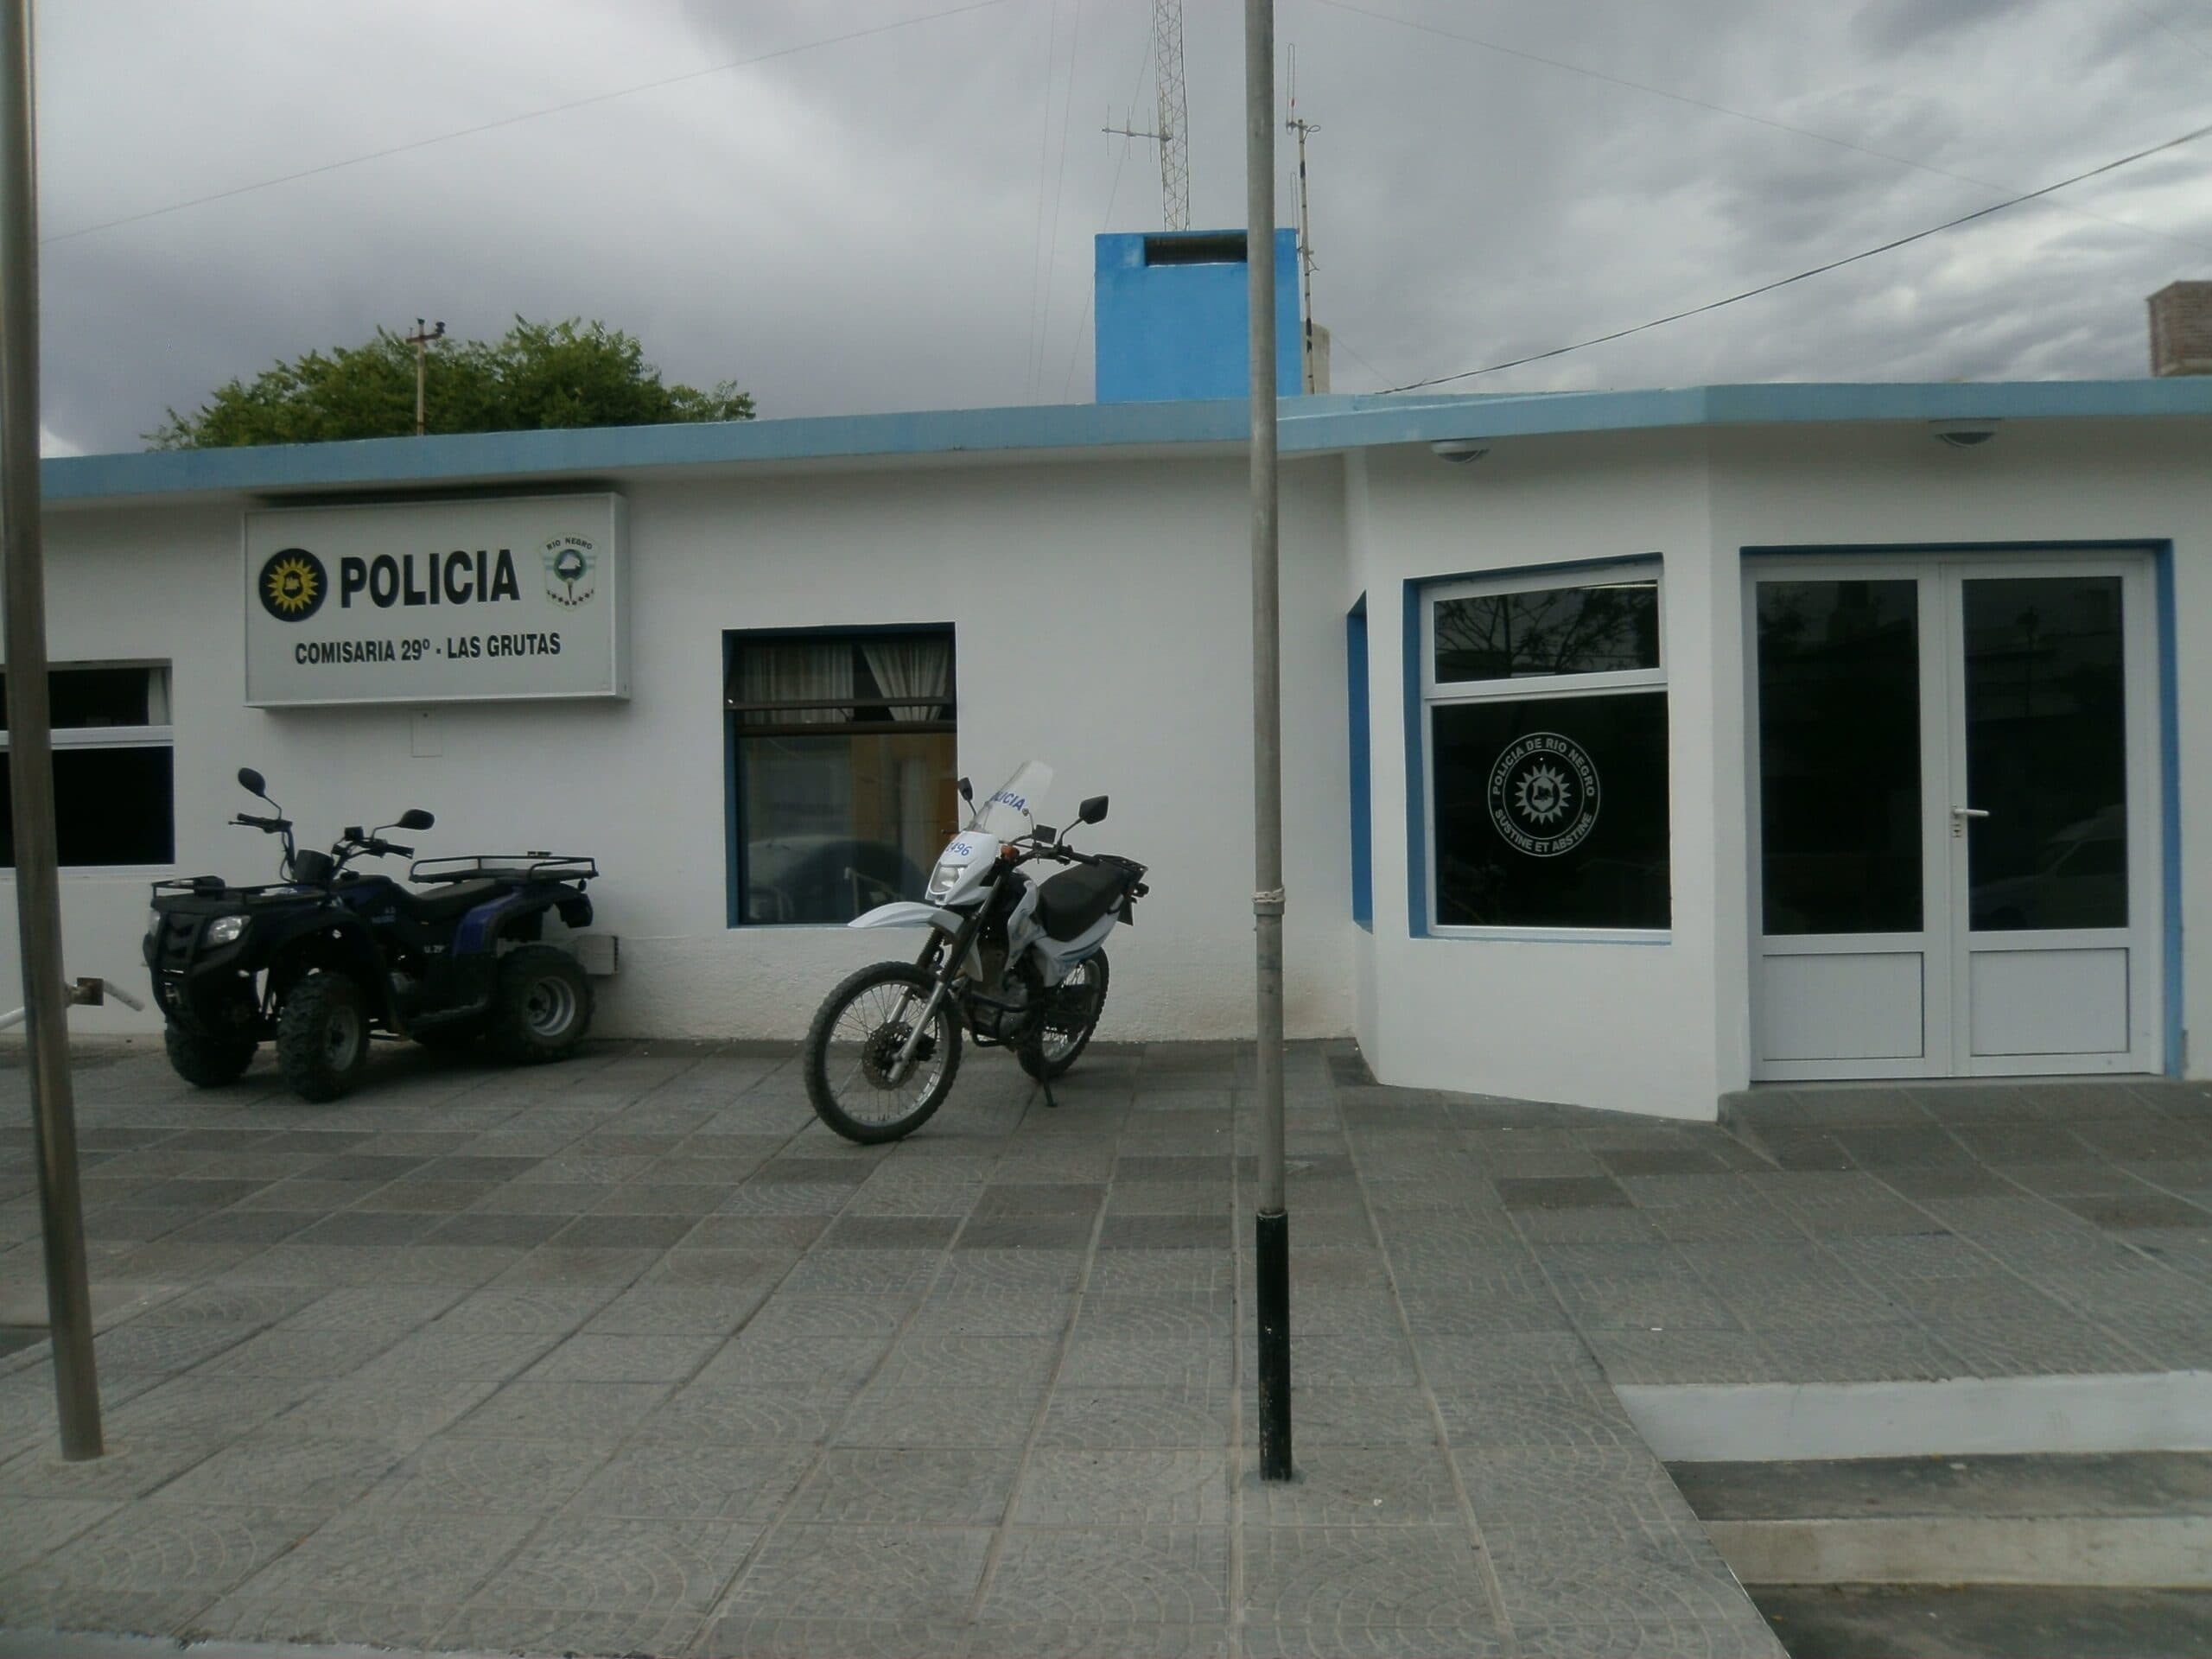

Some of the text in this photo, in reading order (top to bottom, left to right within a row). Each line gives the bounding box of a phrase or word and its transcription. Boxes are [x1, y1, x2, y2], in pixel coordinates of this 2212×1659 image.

[546, 537, 593, 550] RIO NEGRO
[340, 549, 521, 608] POLICIA
[295, 640, 396, 664] COMISARIA
[448, 637, 481, 659] LAS
[486, 632, 562, 658] GRUTAS
[1493, 737, 1595, 798] POLICIA DE RIO NEGRO
[1495, 808, 1592, 852] SUSTINE ET ABSTINE
